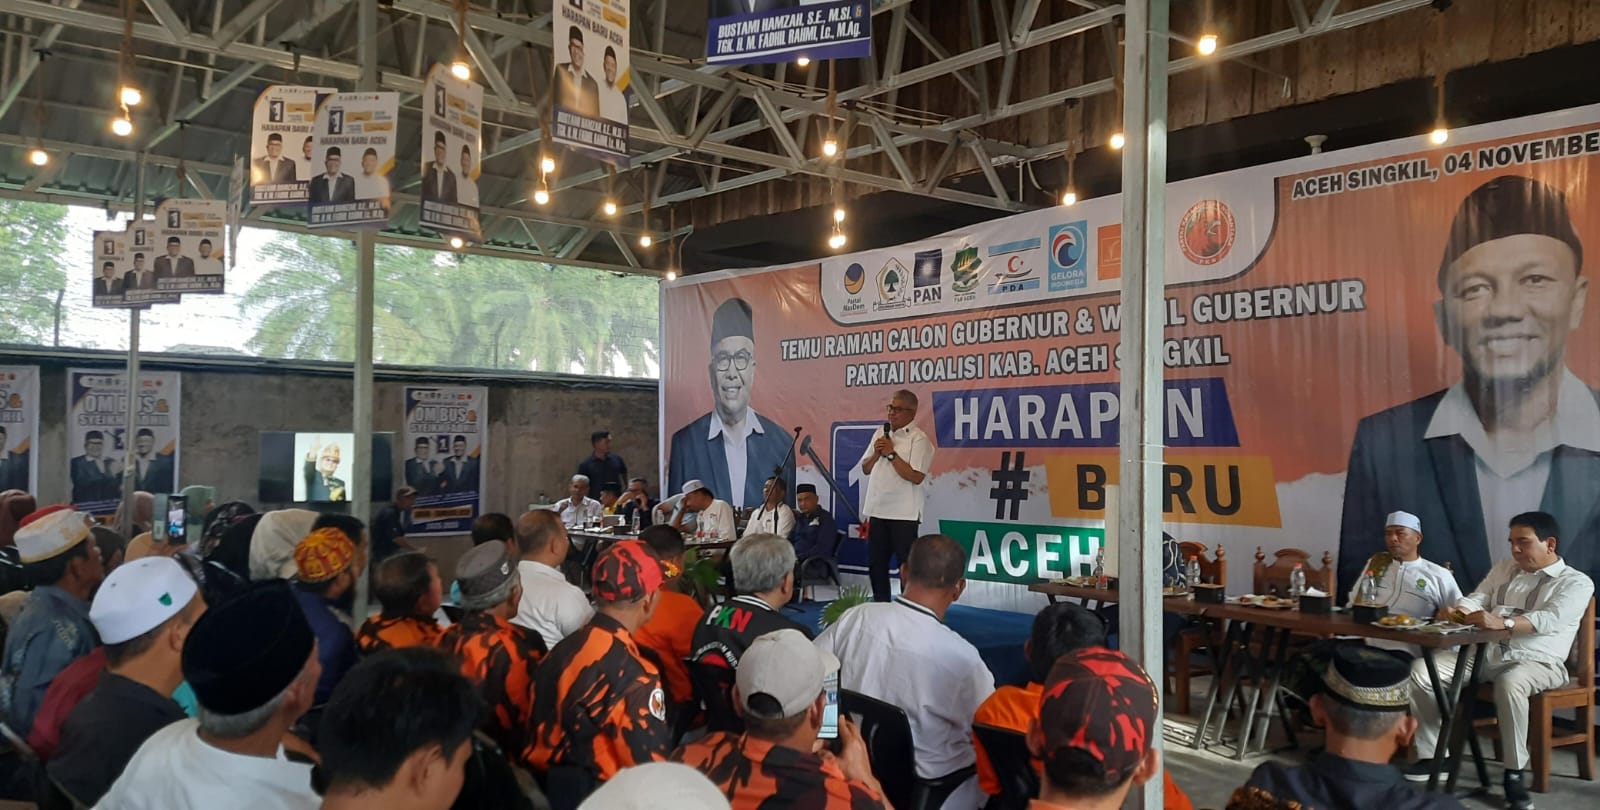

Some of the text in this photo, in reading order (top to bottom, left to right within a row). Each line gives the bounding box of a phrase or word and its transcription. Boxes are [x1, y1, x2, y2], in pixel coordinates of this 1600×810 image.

[718, 19, 760, 38] BUSTAMI
[1293, 174, 1342, 198] ACEH
[1348, 160, 1438, 190] SINGKIL,
[1444, 152, 1472, 174] 04
[914, 286, 942, 303] PAN
[1051, 269, 1084, 280] GELORA
[782, 338, 820, 360] TEMU
[825, 330, 883, 357] RAMAH
[888, 324, 947, 352] CALON
[952, 310, 1068, 344] GUBERNUR
[1074, 308, 1094, 334] &
[1193, 279, 1365, 324] GUBERNUR
[846, 361, 905, 386] PARTAI
[909, 354, 984, 382] KOALISI
[988, 352, 1039, 378] KAB.
[1045, 345, 1108, 374] ACEH
[954, 388, 1204, 440] HARAPN
[990, 451, 1242, 520] # BRU
[968, 530, 1100, 580] ACEH
[706, 604, 753, 633] PKN
